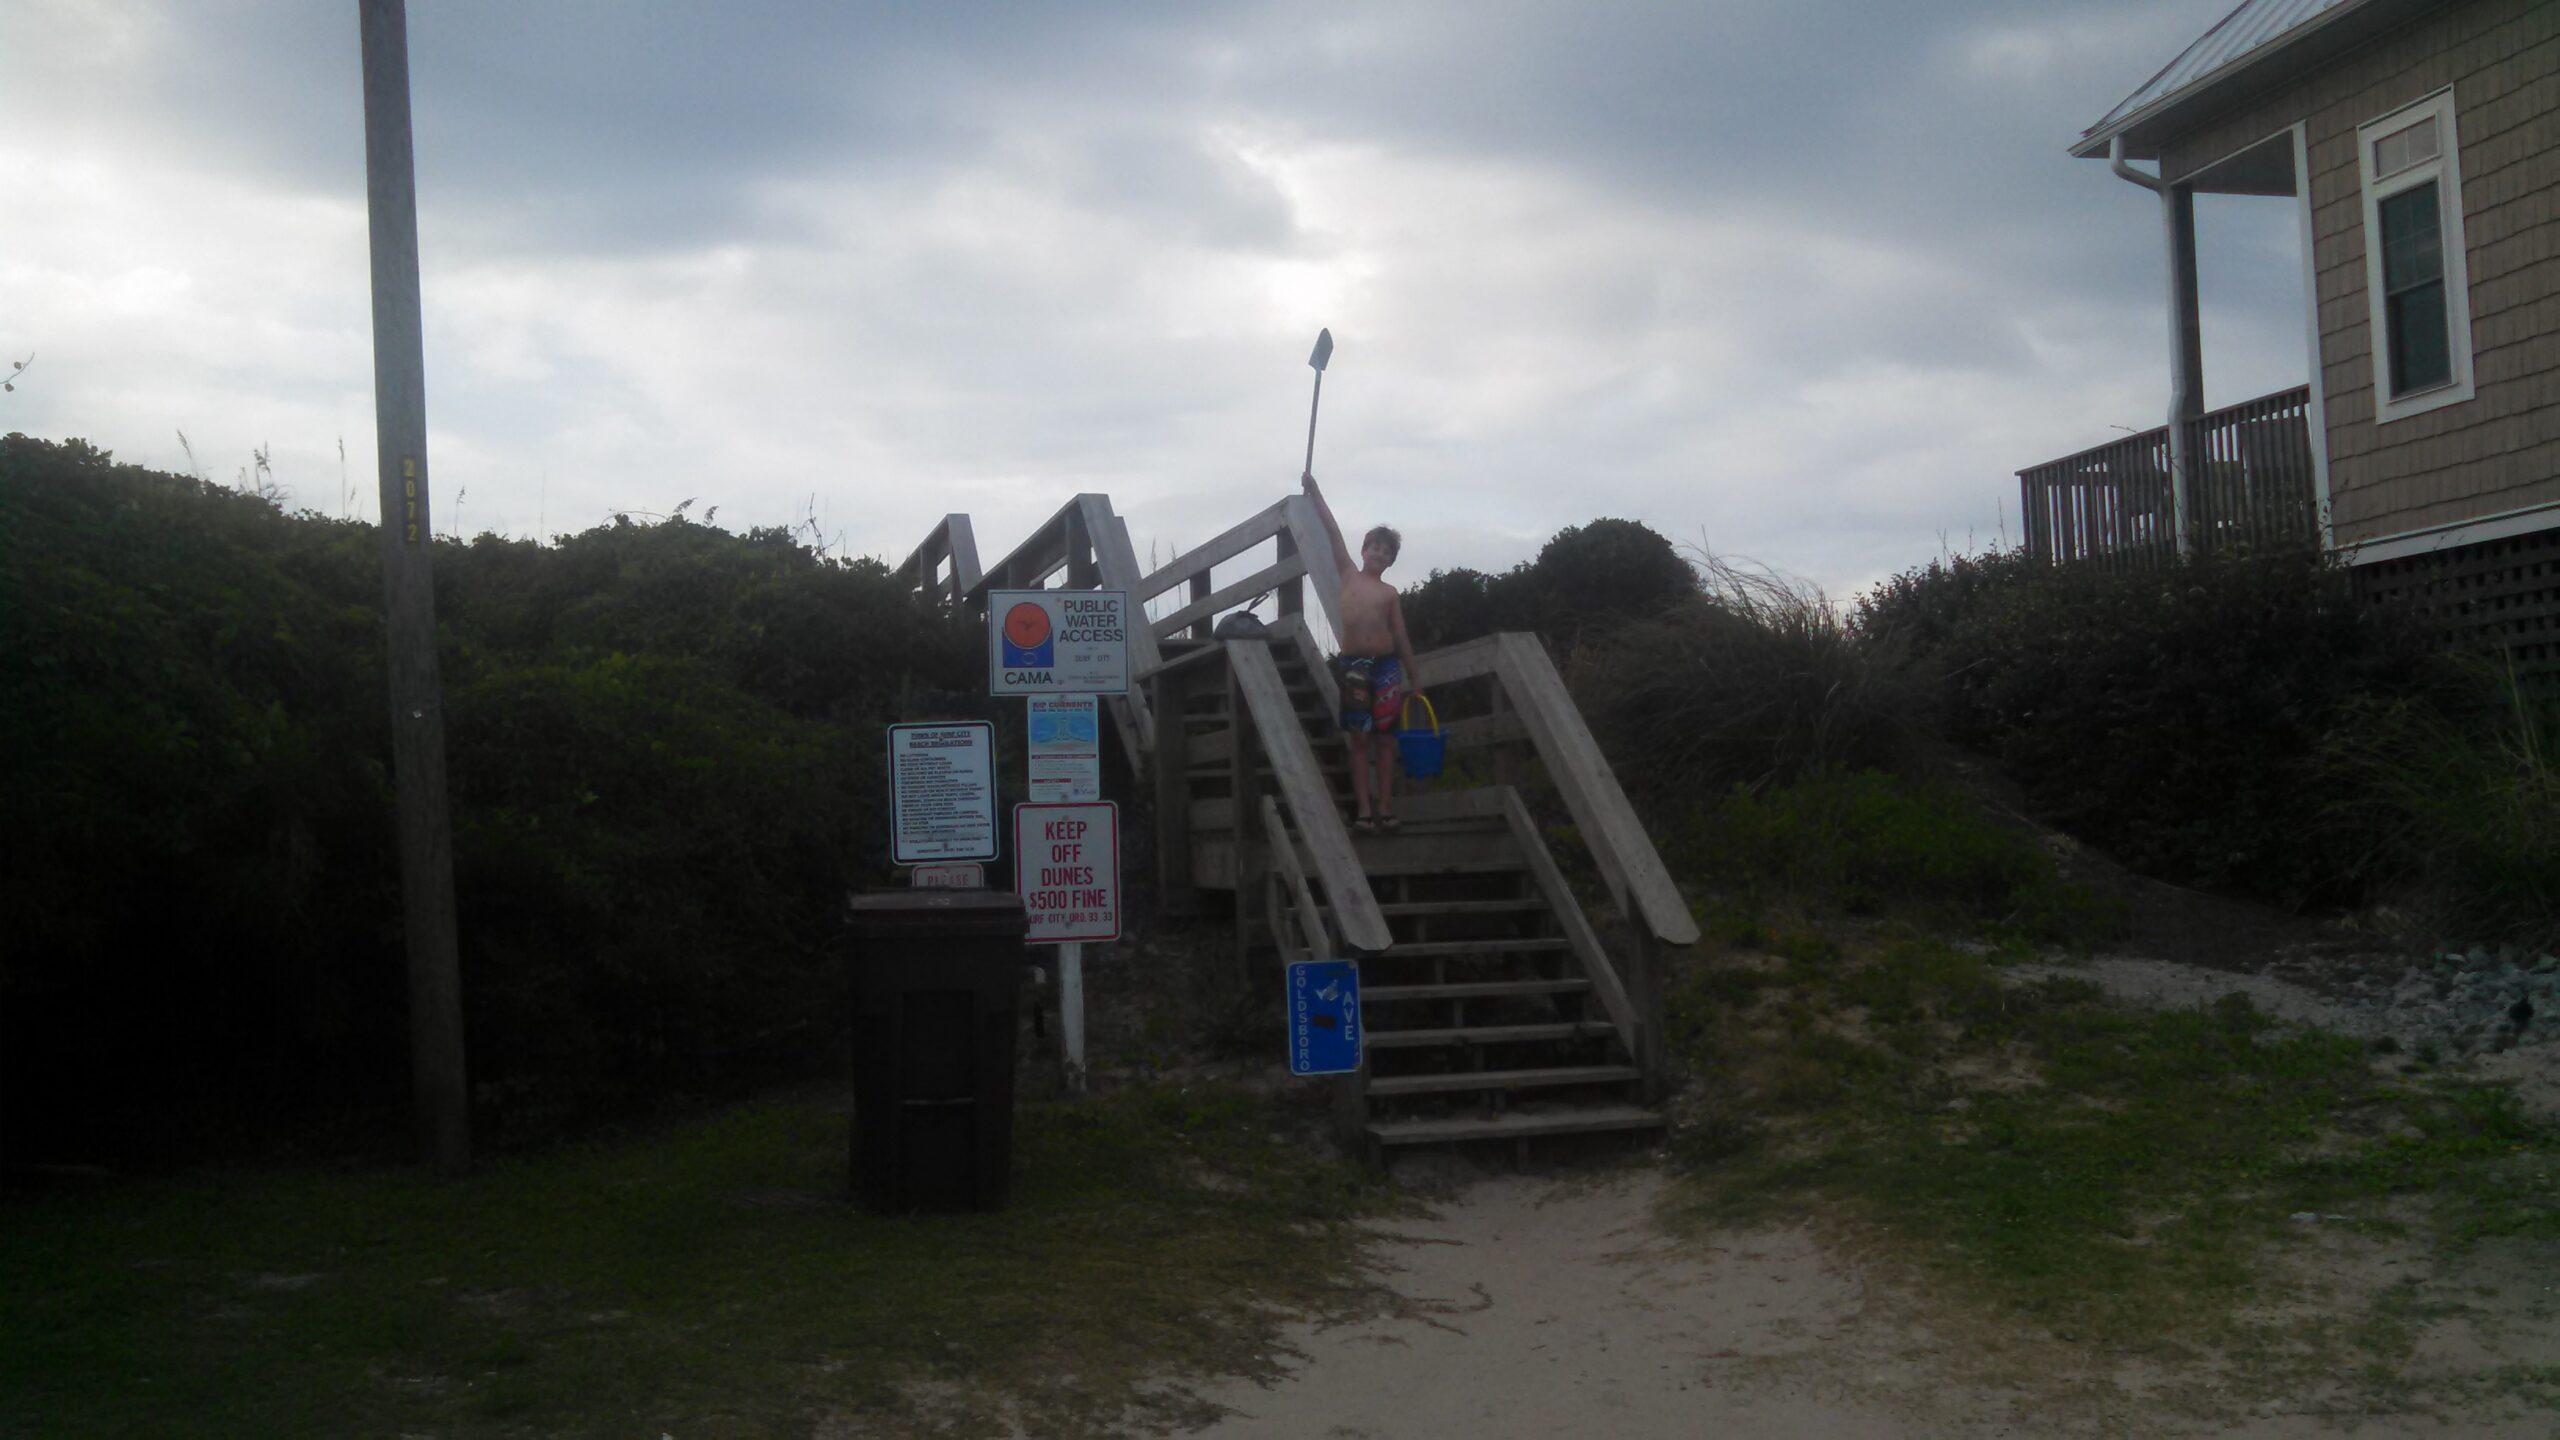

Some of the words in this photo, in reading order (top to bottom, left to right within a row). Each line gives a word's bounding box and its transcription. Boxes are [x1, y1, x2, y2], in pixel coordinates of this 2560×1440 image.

[1064, 600, 1119, 612] PUBLIC
[1065, 615, 1117, 627] WATER
[1059, 629, 1124, 642] ACCESS
[1004, 671, 1054, 684] CAMA
[1045, 821, 1087, 840] KEEP
[1051, 844, 1082, 863] OFF
[1041, 866, 1093, 887] DUNES
[1029, 890, 1067, 910] $500
[1072, 889, 1107, 908] FINE
[1048, 913, 1065, 923] CITY
[1296, 965, 1310, 1071] GOLDSBORO
[1343, 991, 1354, 1040] AVE
